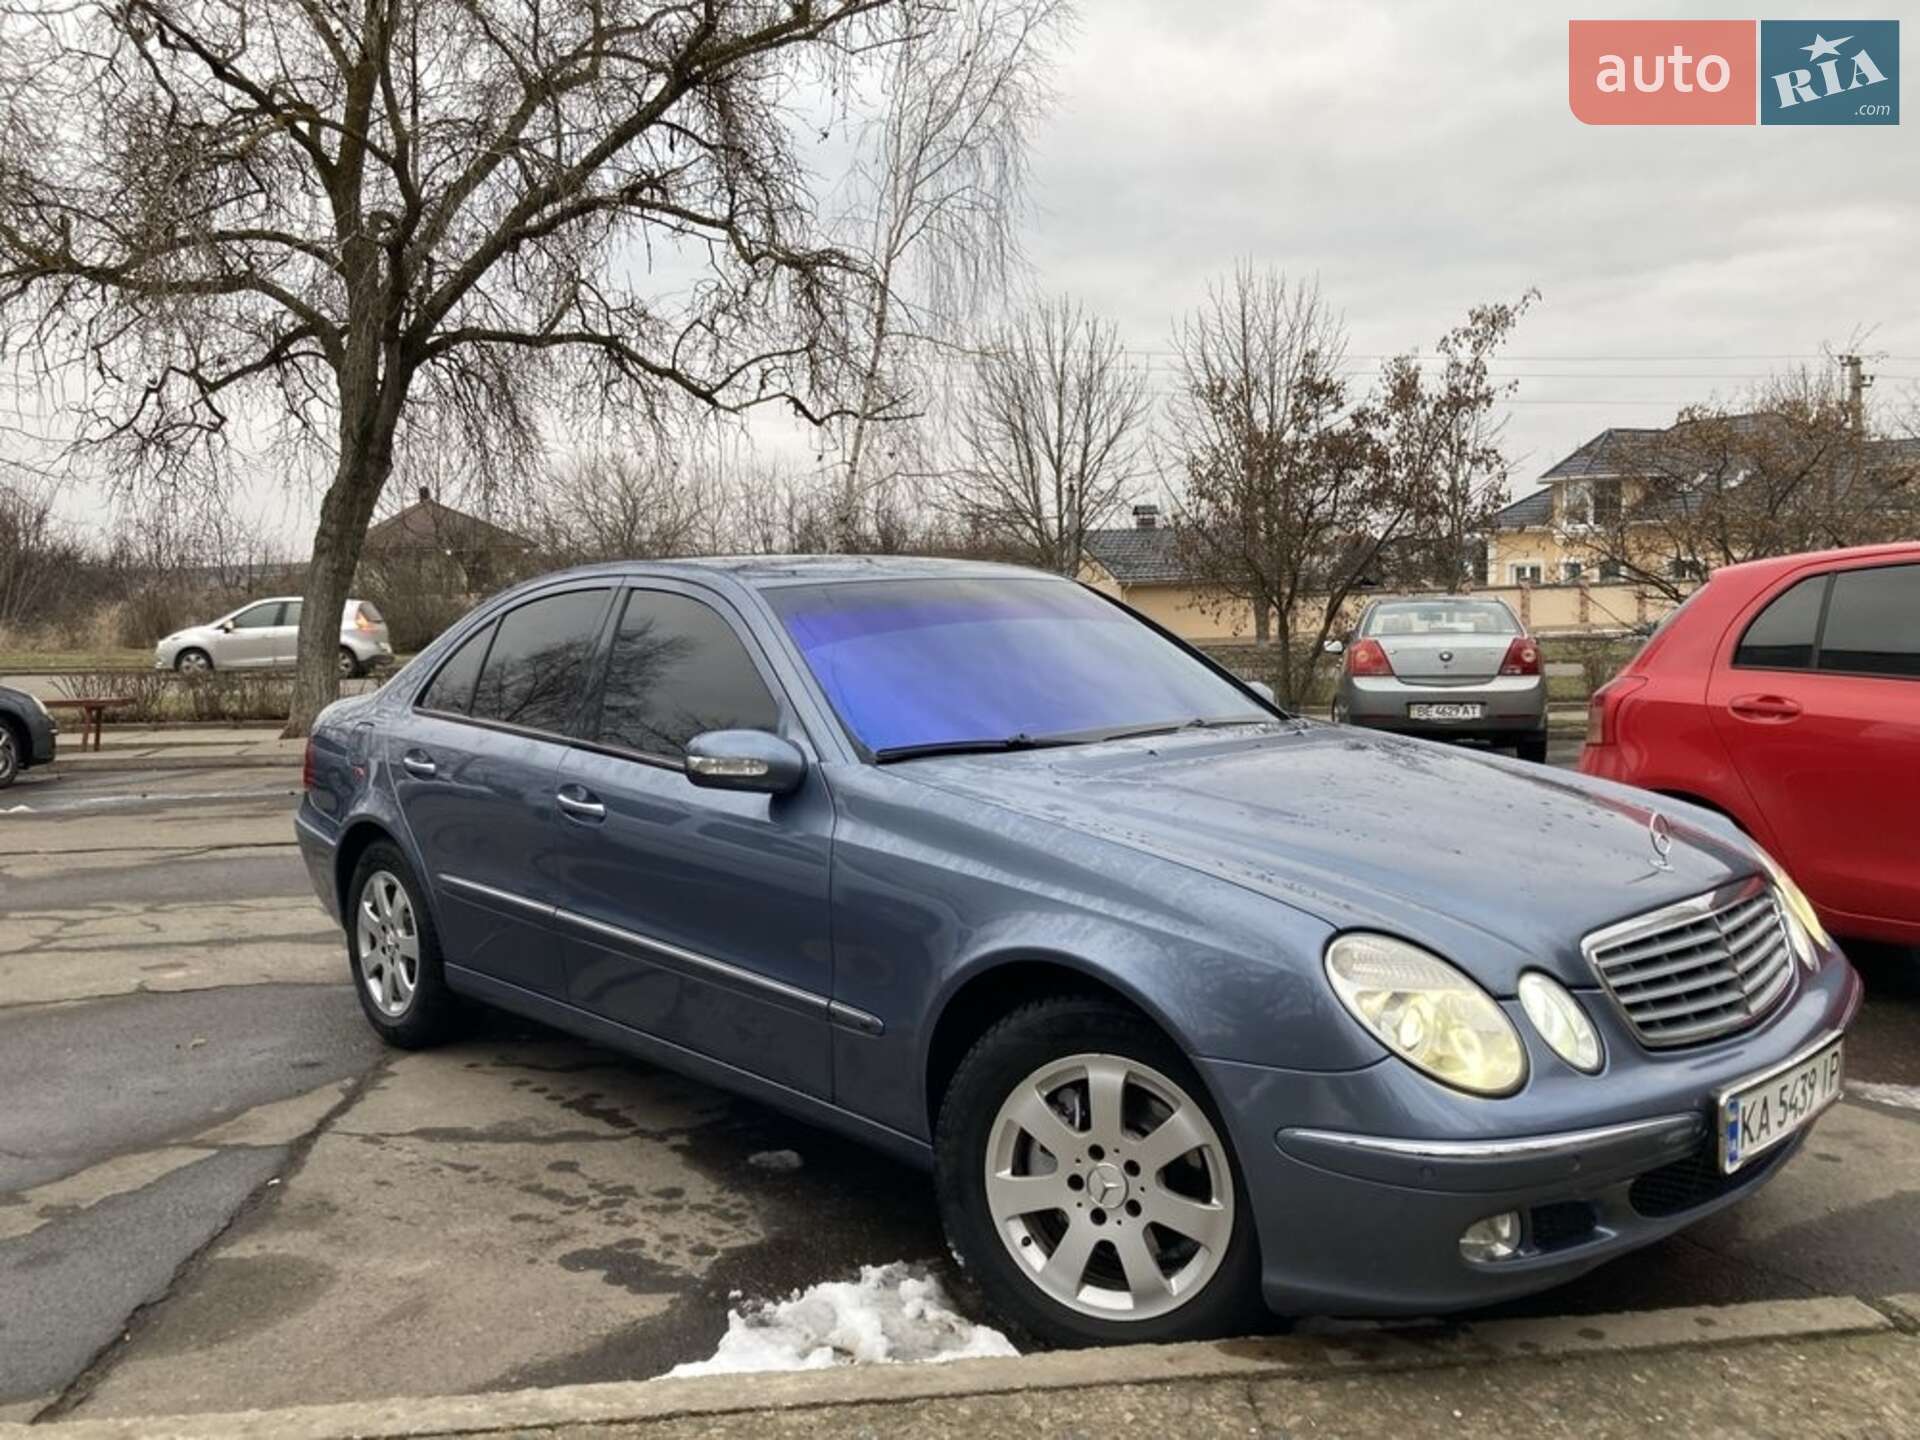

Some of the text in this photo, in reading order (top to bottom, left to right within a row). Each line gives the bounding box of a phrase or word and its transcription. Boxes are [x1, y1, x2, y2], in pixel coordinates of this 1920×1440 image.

[1462, 706, 1478, 717] AT
[1741, 1051, 1840, 1149] KA 5439 IP
